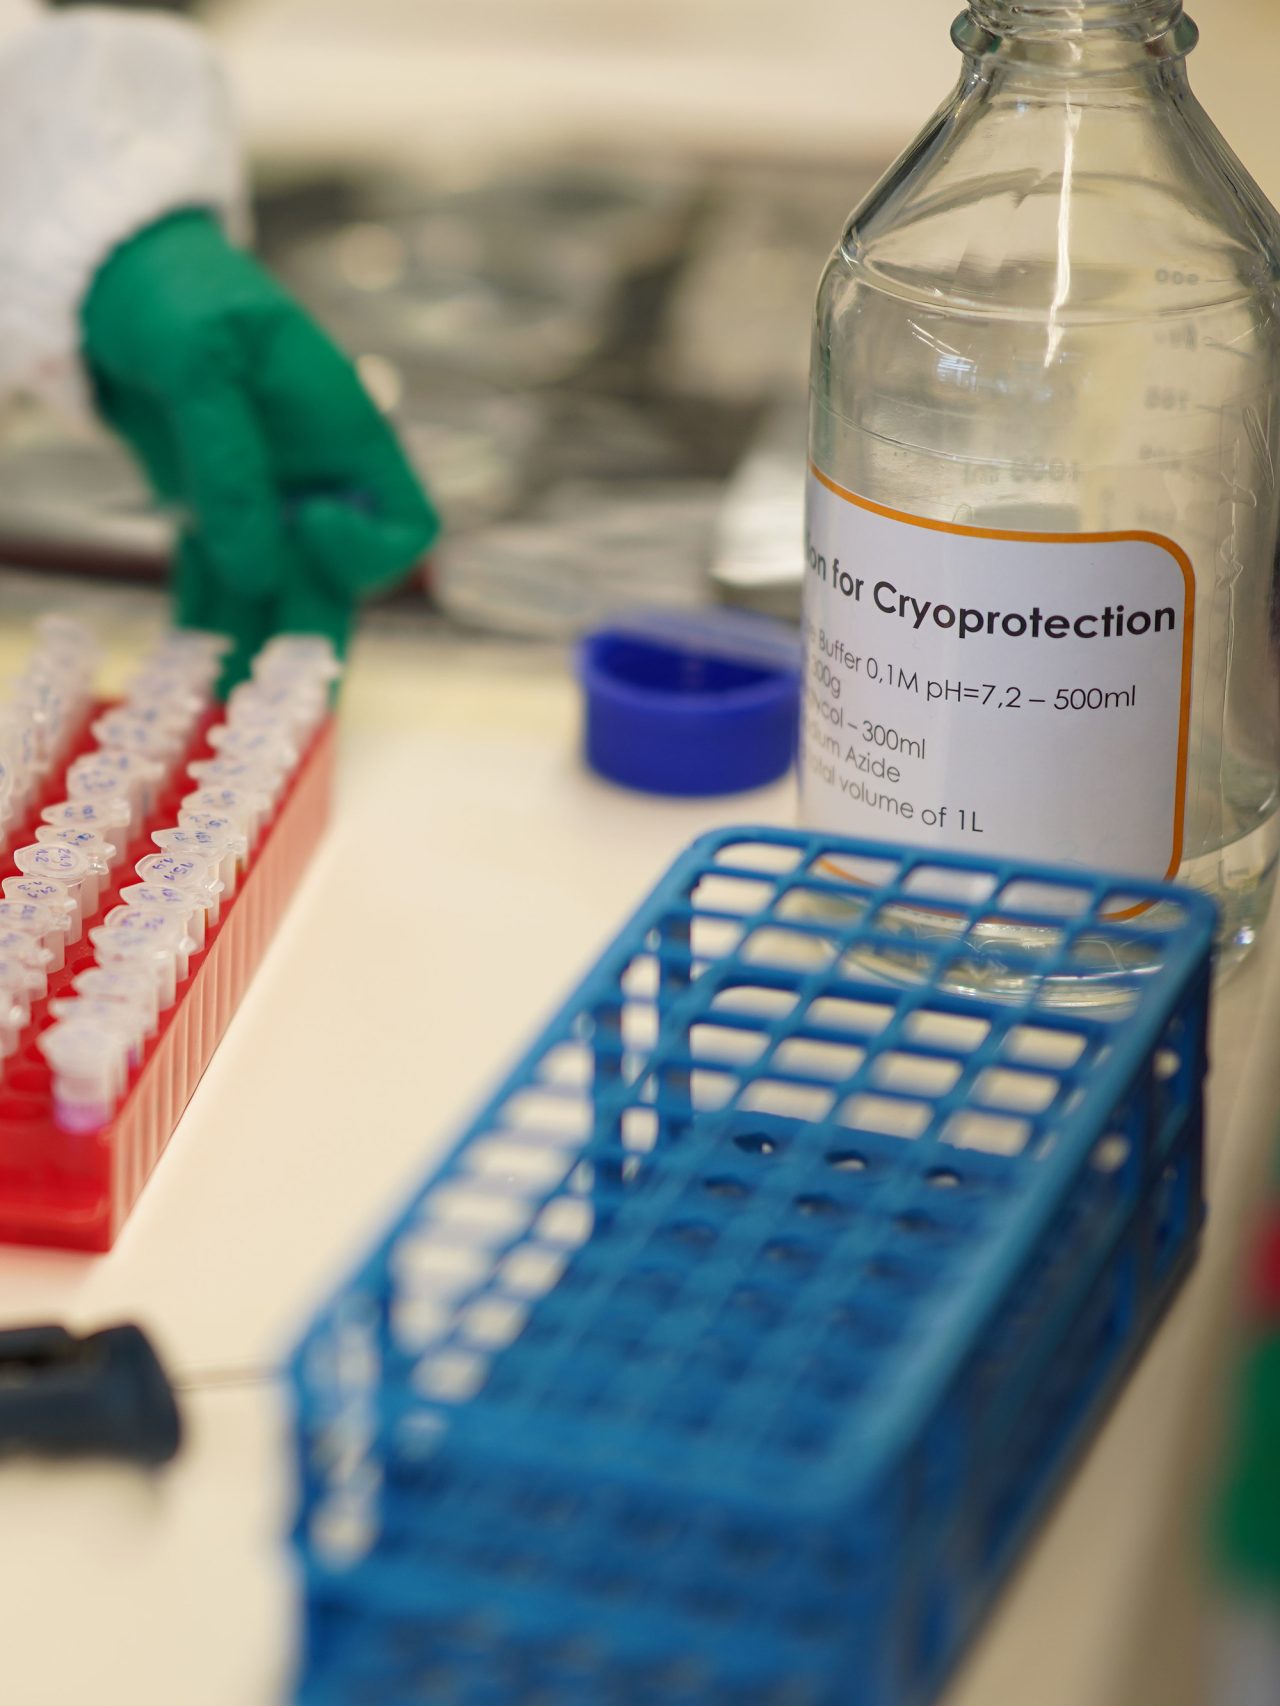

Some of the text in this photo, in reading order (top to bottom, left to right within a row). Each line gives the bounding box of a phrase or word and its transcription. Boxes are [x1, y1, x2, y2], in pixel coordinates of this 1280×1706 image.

[807, 545, 1176, 639] on for Cryoprotection
[819, 628, 862, 672] Buffer
[866, 657, 919, 693] 0,1M
[926, 679, 1021, 709] pH=7,2
[1053, 685, 1136, 710] 500ml
[845, 745, 901, 783] Azide
[862, 719, 926, 760] 300ml
[839, 775, 915, 819] volume
[921, 806, 948, 829] of
[958, 809, 985, 833] 1L
